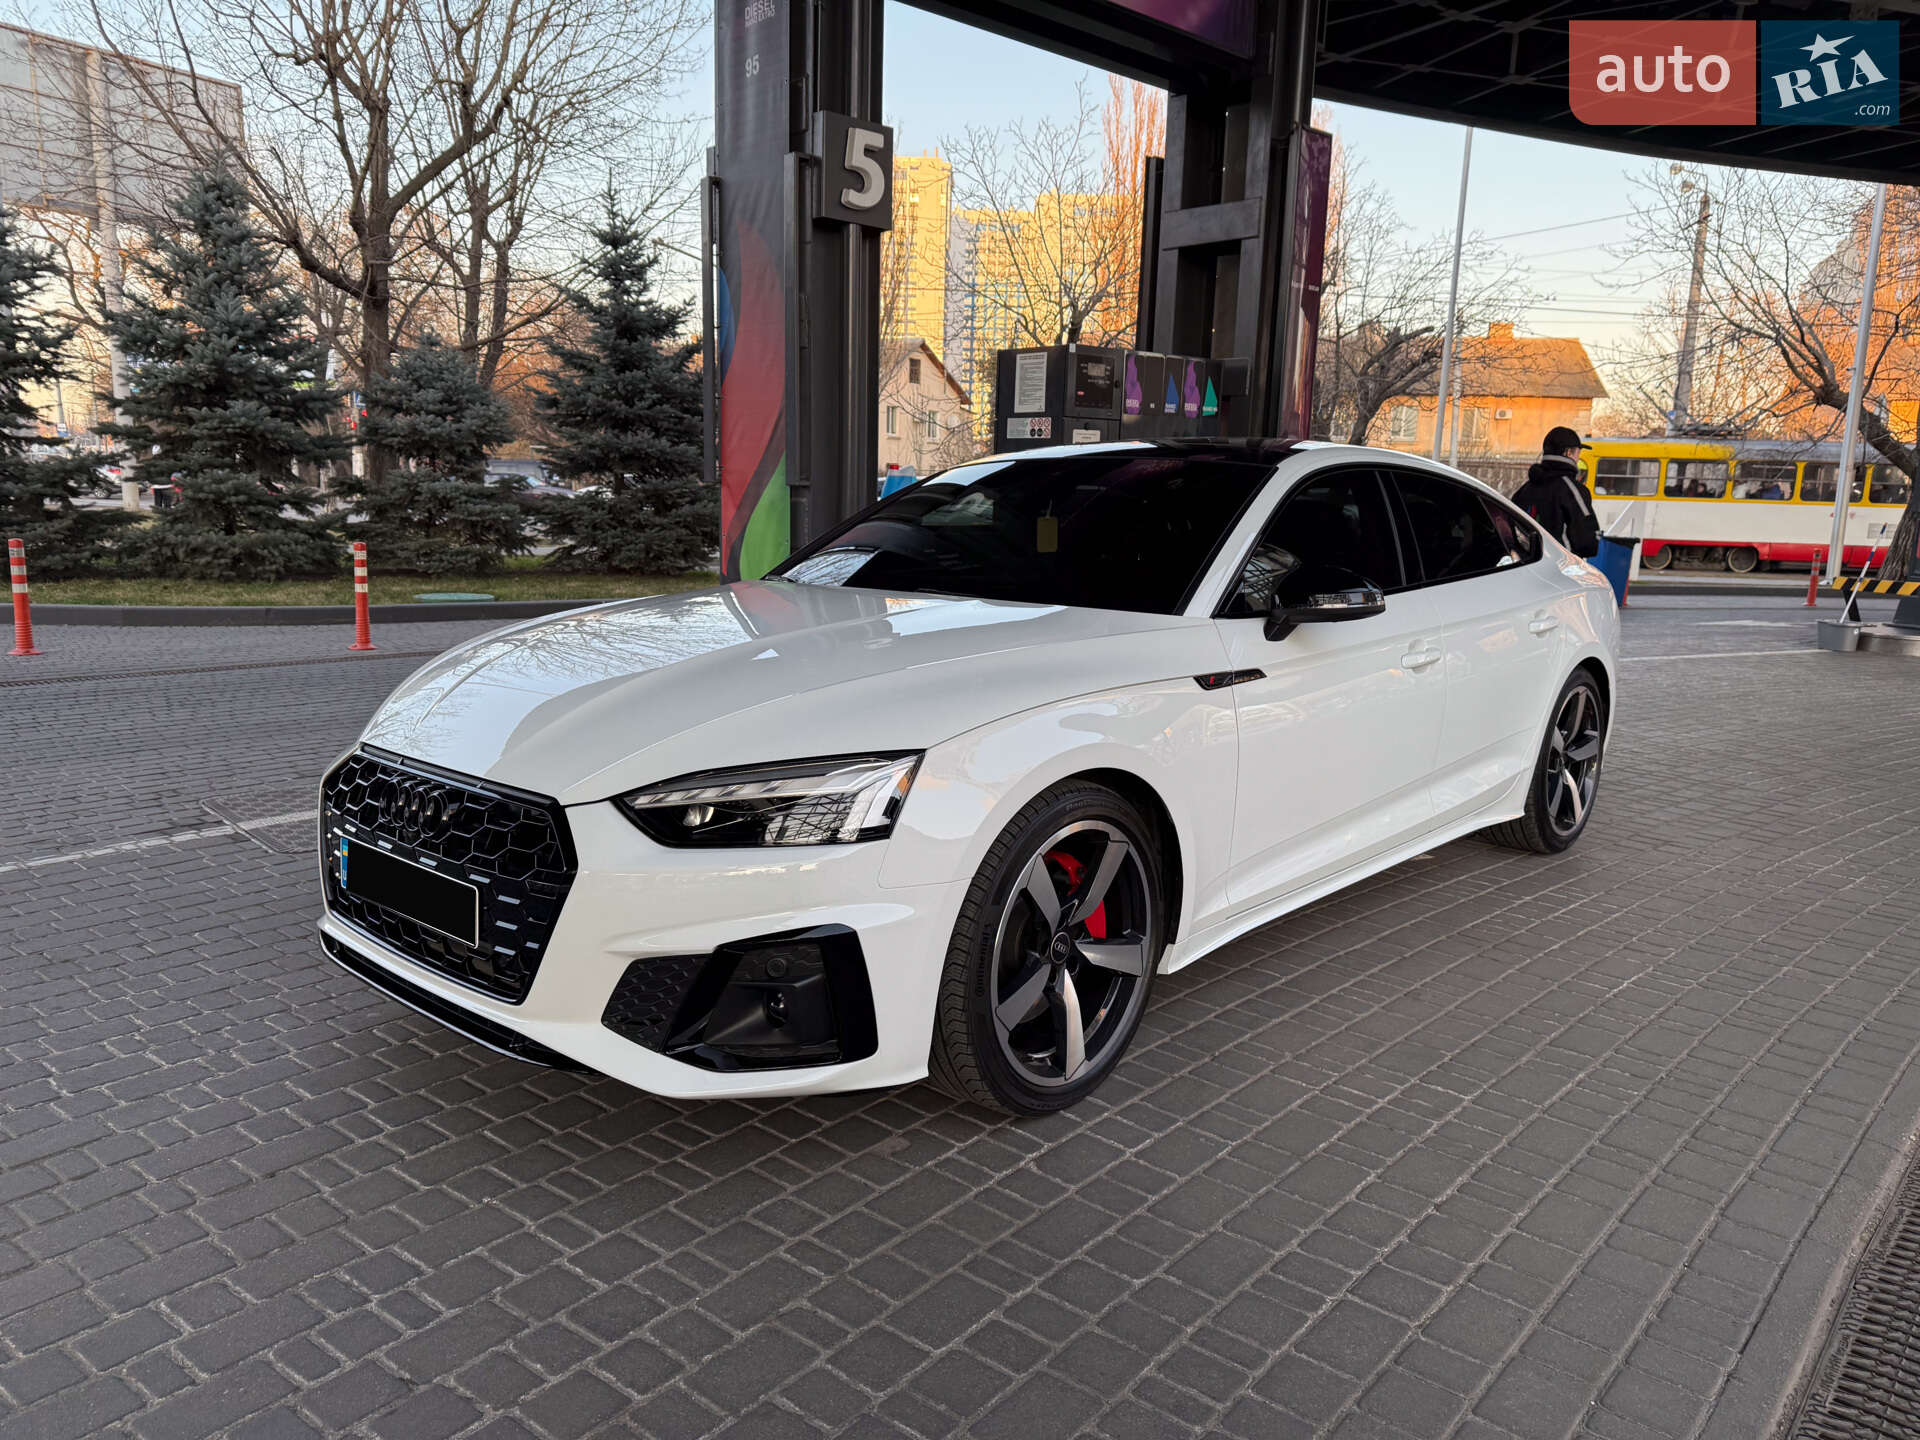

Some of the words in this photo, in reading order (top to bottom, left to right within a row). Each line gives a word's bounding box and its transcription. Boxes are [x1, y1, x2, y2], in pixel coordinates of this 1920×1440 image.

[745, 0, 775, 19] DIESEL
[745, 54, 760, 77] 95
[841, 127, 885, 210] 5
